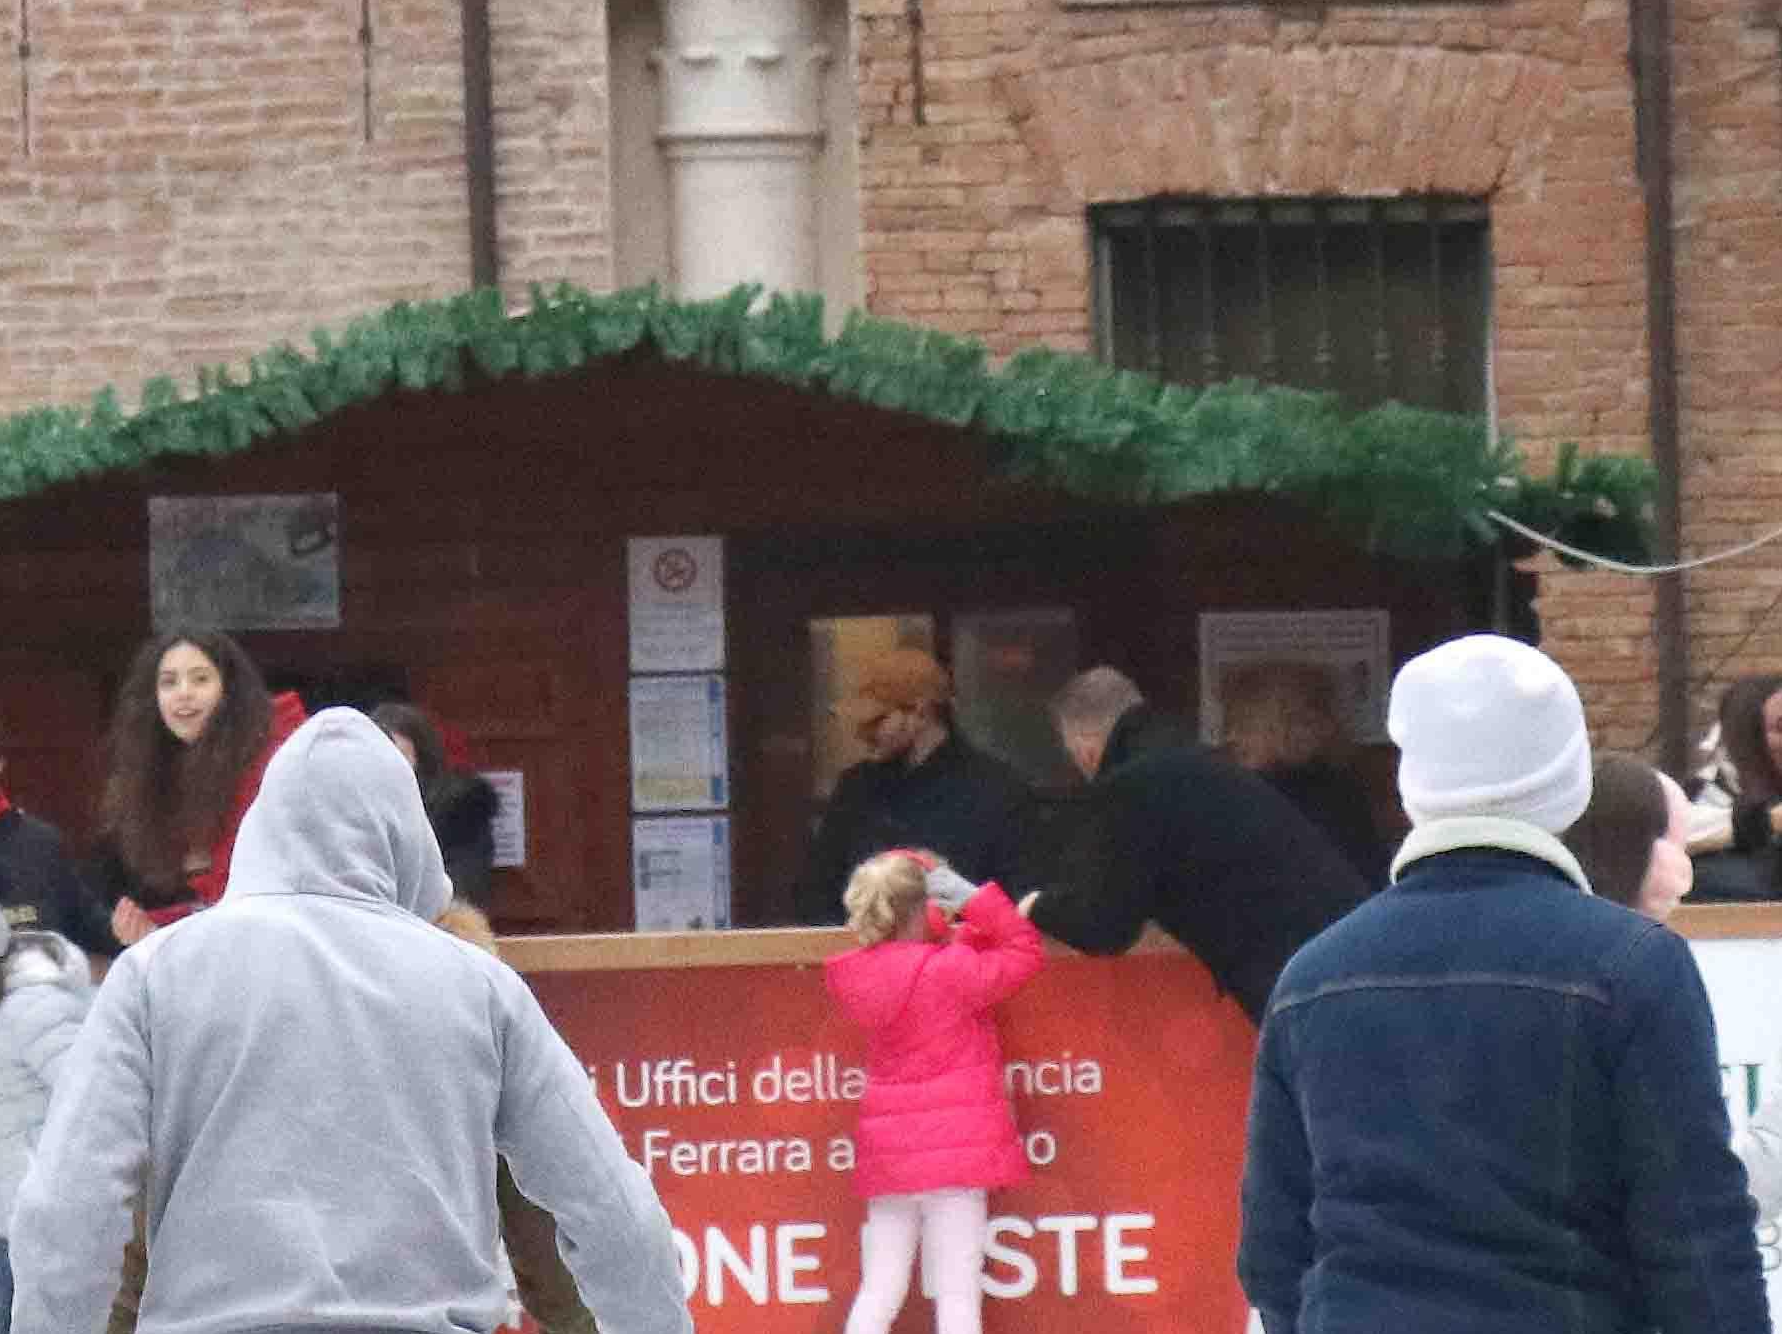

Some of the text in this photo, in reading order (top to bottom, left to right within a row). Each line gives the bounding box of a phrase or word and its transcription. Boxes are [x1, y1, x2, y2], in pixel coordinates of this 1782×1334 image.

[616, 1057, 737, 1108] Uffici
[752, 1054, 869, 1103] della
[1004, 1051, 1104, 1095] ncia
[642, 1129, 812, 1177] Ferrara
[919, 1212, 1160, 1301] STE
